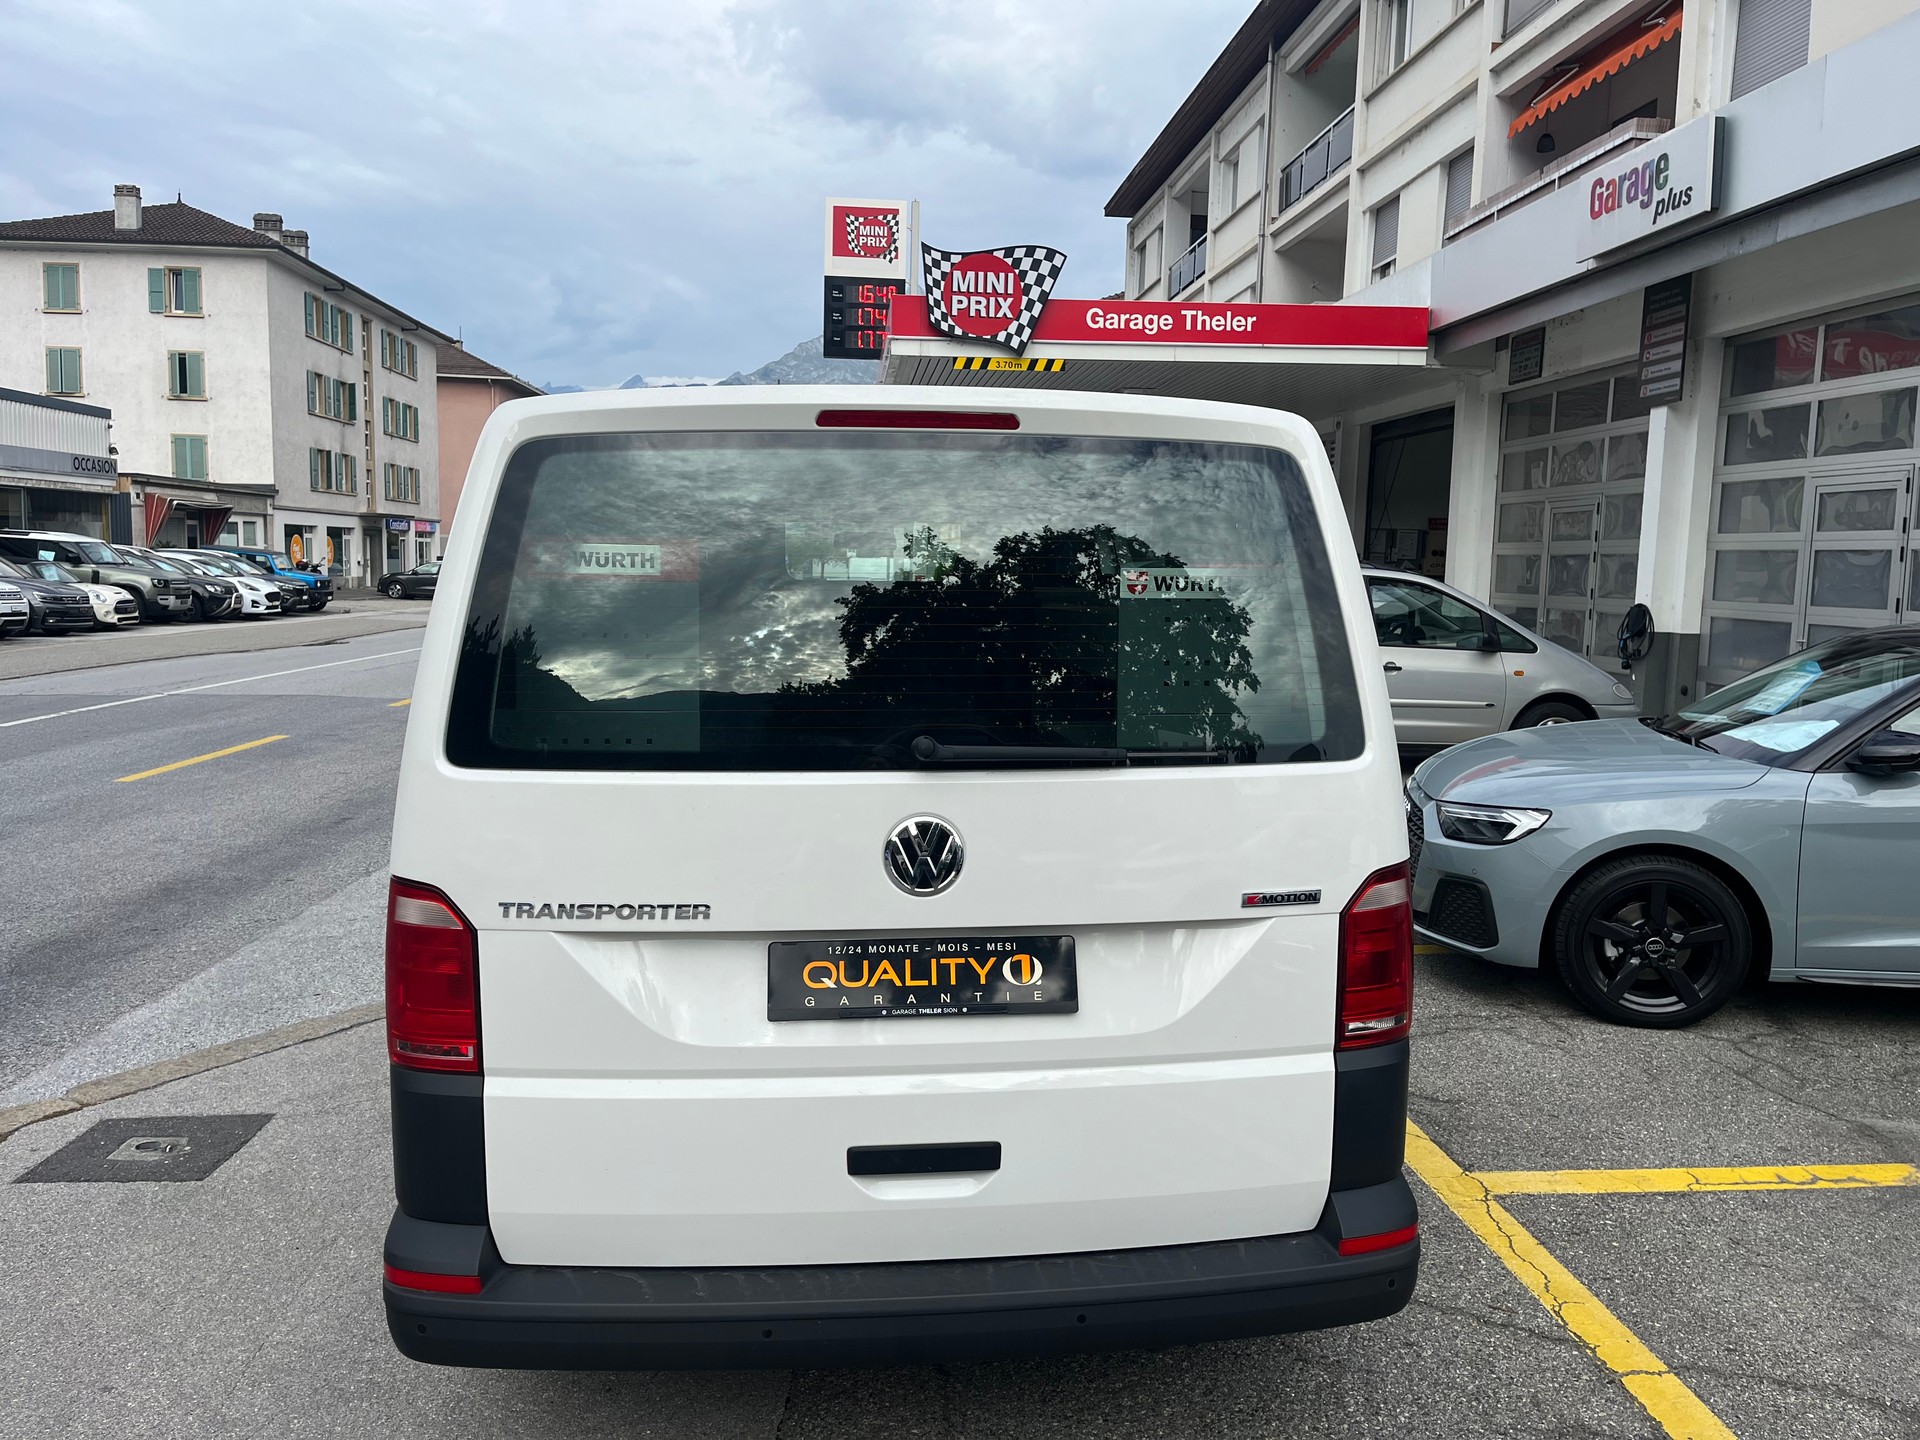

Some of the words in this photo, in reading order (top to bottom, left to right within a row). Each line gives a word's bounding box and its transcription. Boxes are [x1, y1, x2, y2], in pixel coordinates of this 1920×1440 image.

[1590, 152, 1670, 220] Garage
[1652, 186, 1693, 225] plus
[859, 225, 888, 237] MINI
[859, 236, 888, 248] PRIX
[952, 270, 1014, 295] MINI
[951, 295, 1014, 319] PRIX
[1086, 308, 1174, 335] Garage
[1181, 310, 1257, 332] Theler
[73, 456, 117, 474] OCCASION
[575, 551, 655, 569] WÜRTH
[1153, 575, 1231, 592] WÜRT
[498, 902, 711, 920] TRANSPORTER
[827, 946, 862, 954] 12/24
[868, 944, 919, 954] MONATE
[938, 943, 969, 952] MOIS
[986, 942, 1017, 951] MESI
[802, 956, 997, 988] QUALITY
[804, 990, 1043, 1007] GARANTIE
